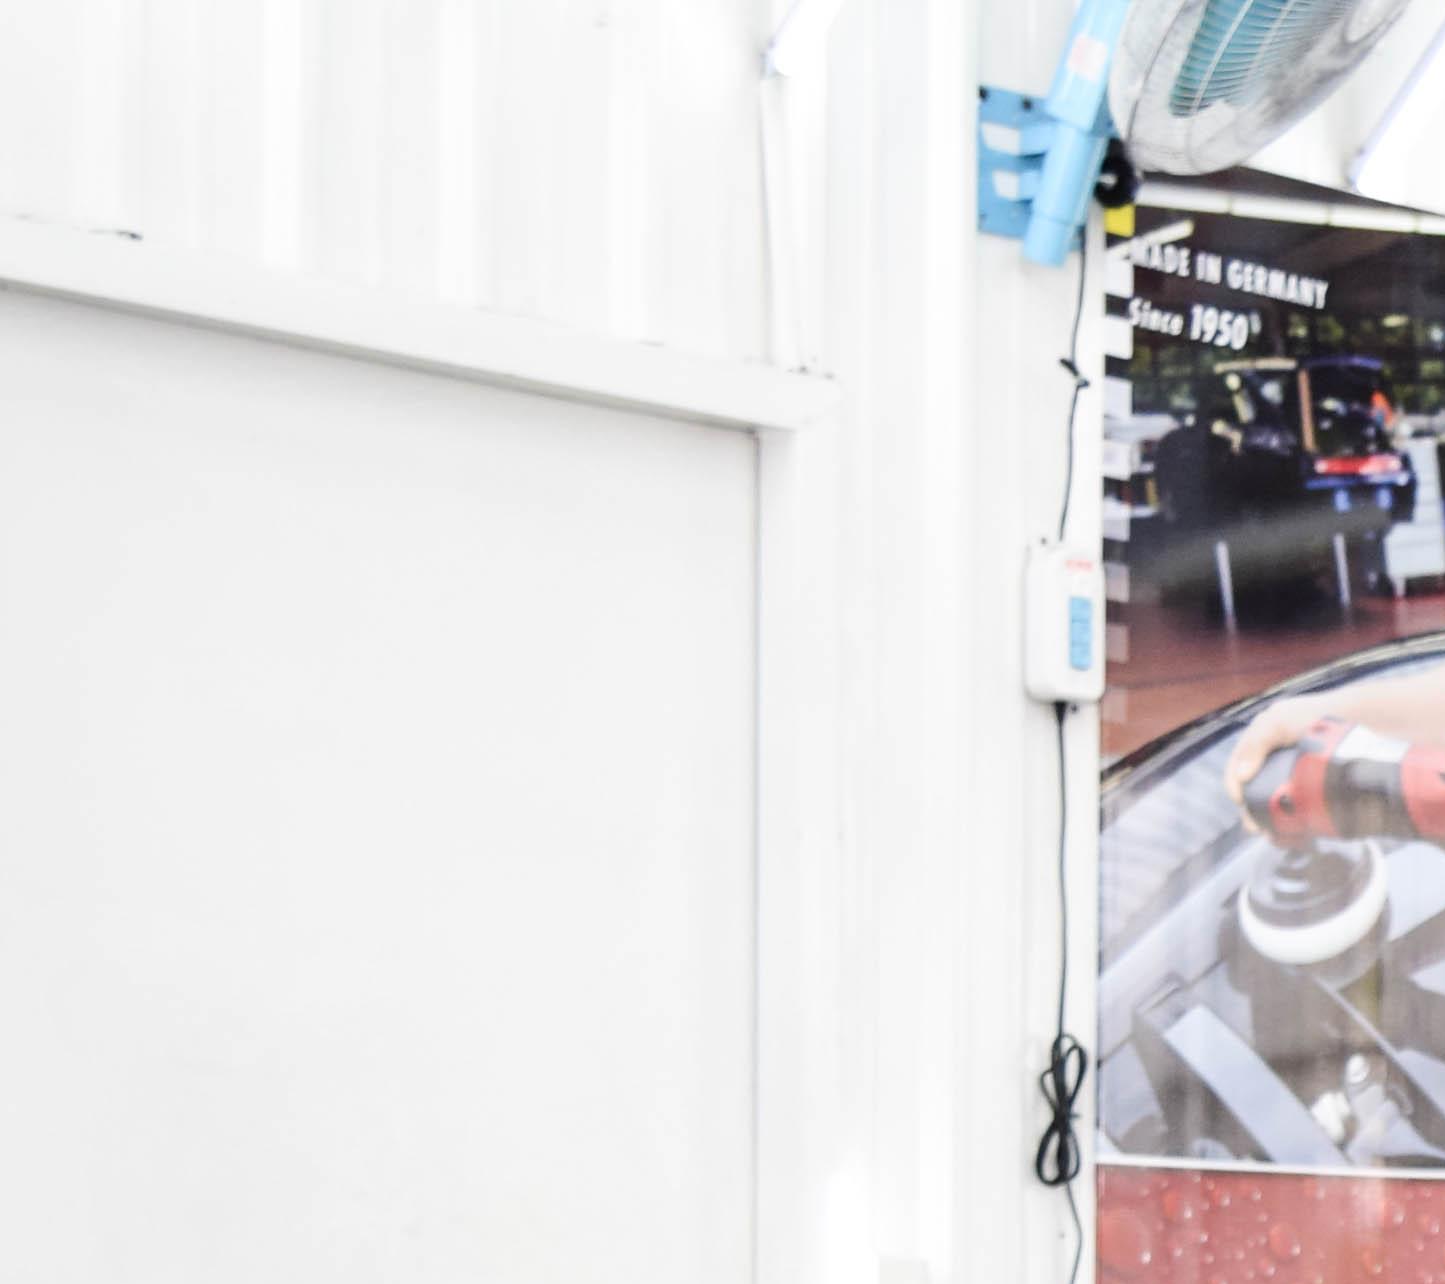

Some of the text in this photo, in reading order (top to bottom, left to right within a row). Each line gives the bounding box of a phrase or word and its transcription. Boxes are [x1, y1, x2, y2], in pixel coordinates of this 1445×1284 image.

[1130, 238, 1329, 310] MADE IN GERMANY
[1129, 297, 1250, 351] Since 1950
